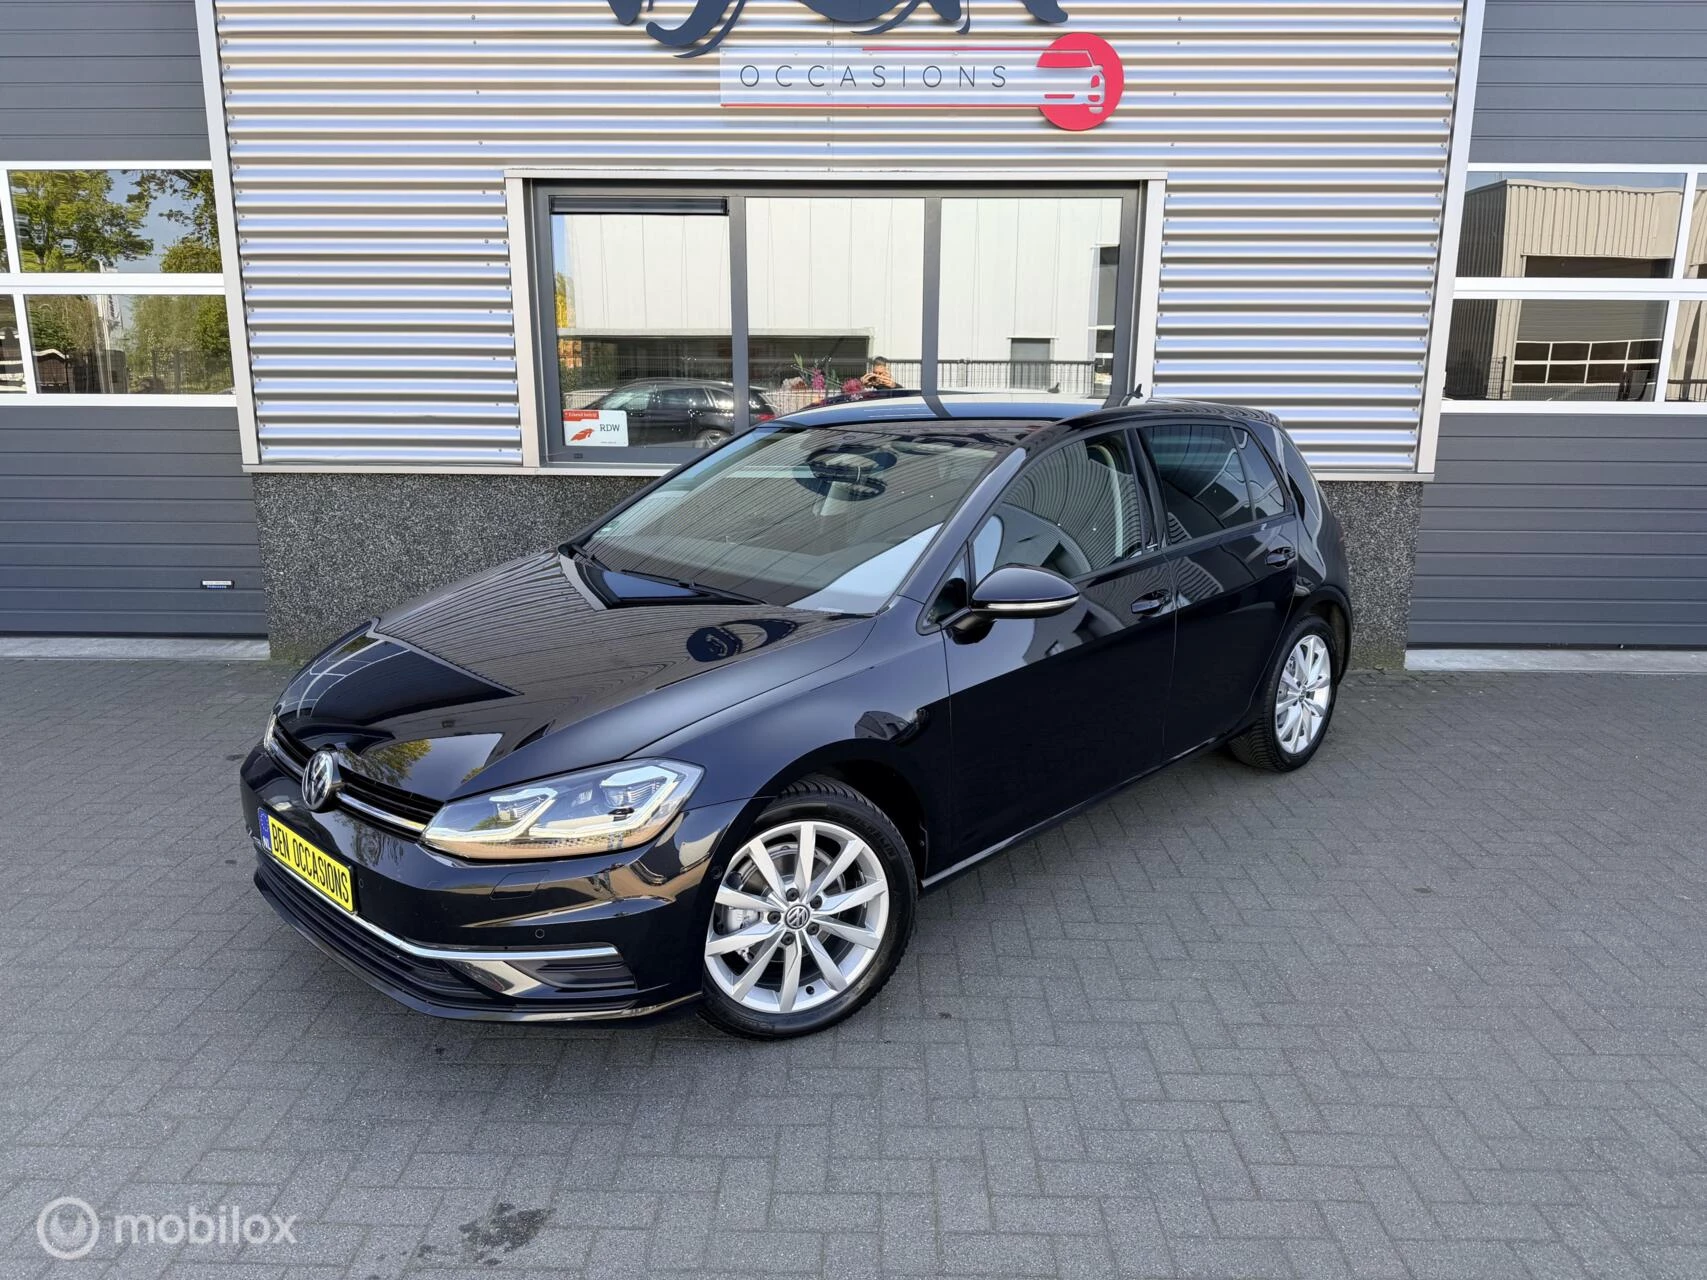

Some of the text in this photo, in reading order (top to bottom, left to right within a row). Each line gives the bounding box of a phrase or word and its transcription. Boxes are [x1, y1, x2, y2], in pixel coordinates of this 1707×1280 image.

[739, 64, 1007, 89] OCCASIONS
[599, 423, 621, 432] RDW
[271, 823, 350, 905] BEN OCCASIONS
